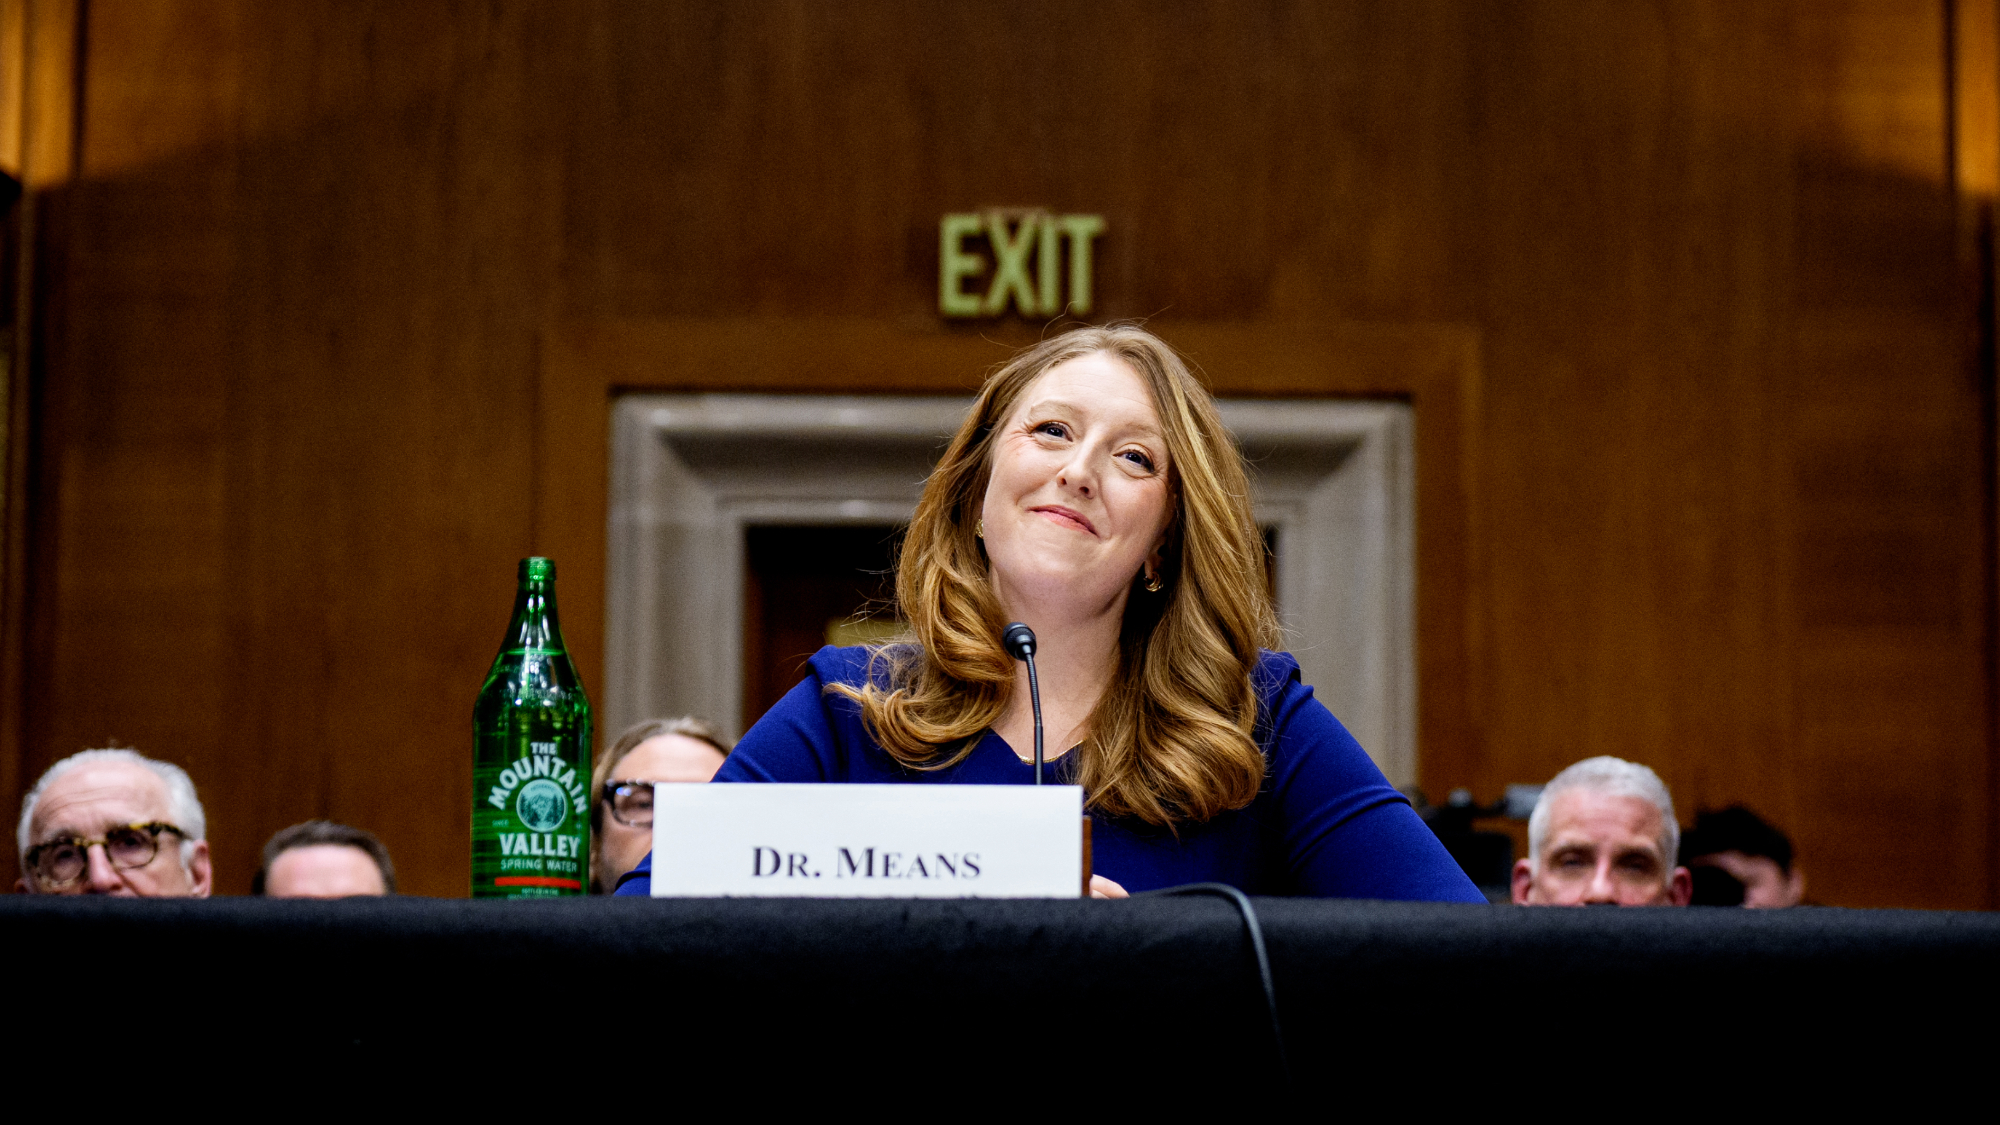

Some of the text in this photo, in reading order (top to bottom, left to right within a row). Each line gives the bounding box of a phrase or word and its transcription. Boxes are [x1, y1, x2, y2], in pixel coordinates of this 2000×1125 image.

[941, 212, 1106, 315] EXIT
[530, 742, 557, 754] THE
[488, 755, 588, 814] MOUNTAIN
[499, 833, 581, 858] VALLEY
[501, 858, 578, 872] SPRING WATER
